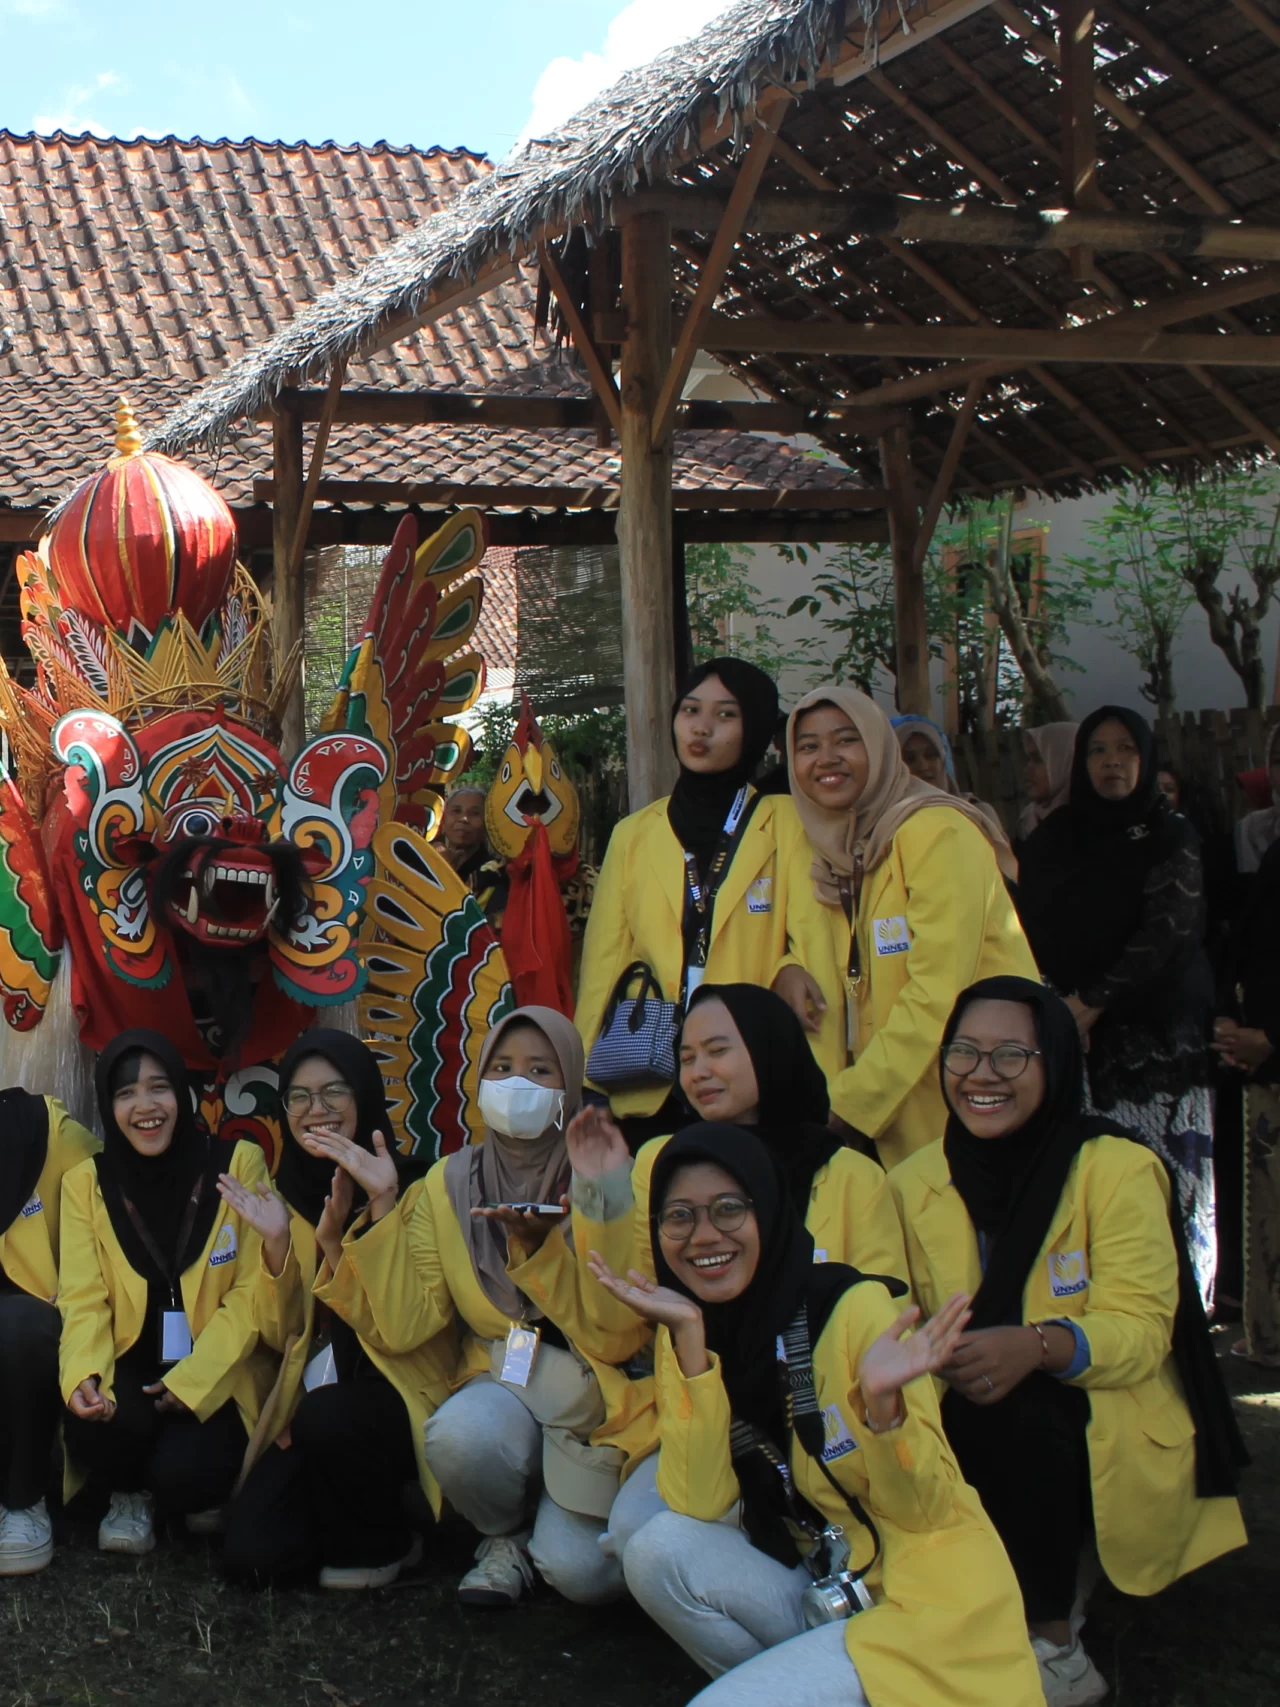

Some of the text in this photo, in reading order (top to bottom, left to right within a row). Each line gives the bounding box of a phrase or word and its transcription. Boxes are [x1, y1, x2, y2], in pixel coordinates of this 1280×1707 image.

[878, 942, 909, 953] UNNES
[1053, 1279, 1087, 1295] UNNES
[823, 1438, 857, 1459] UNNES
